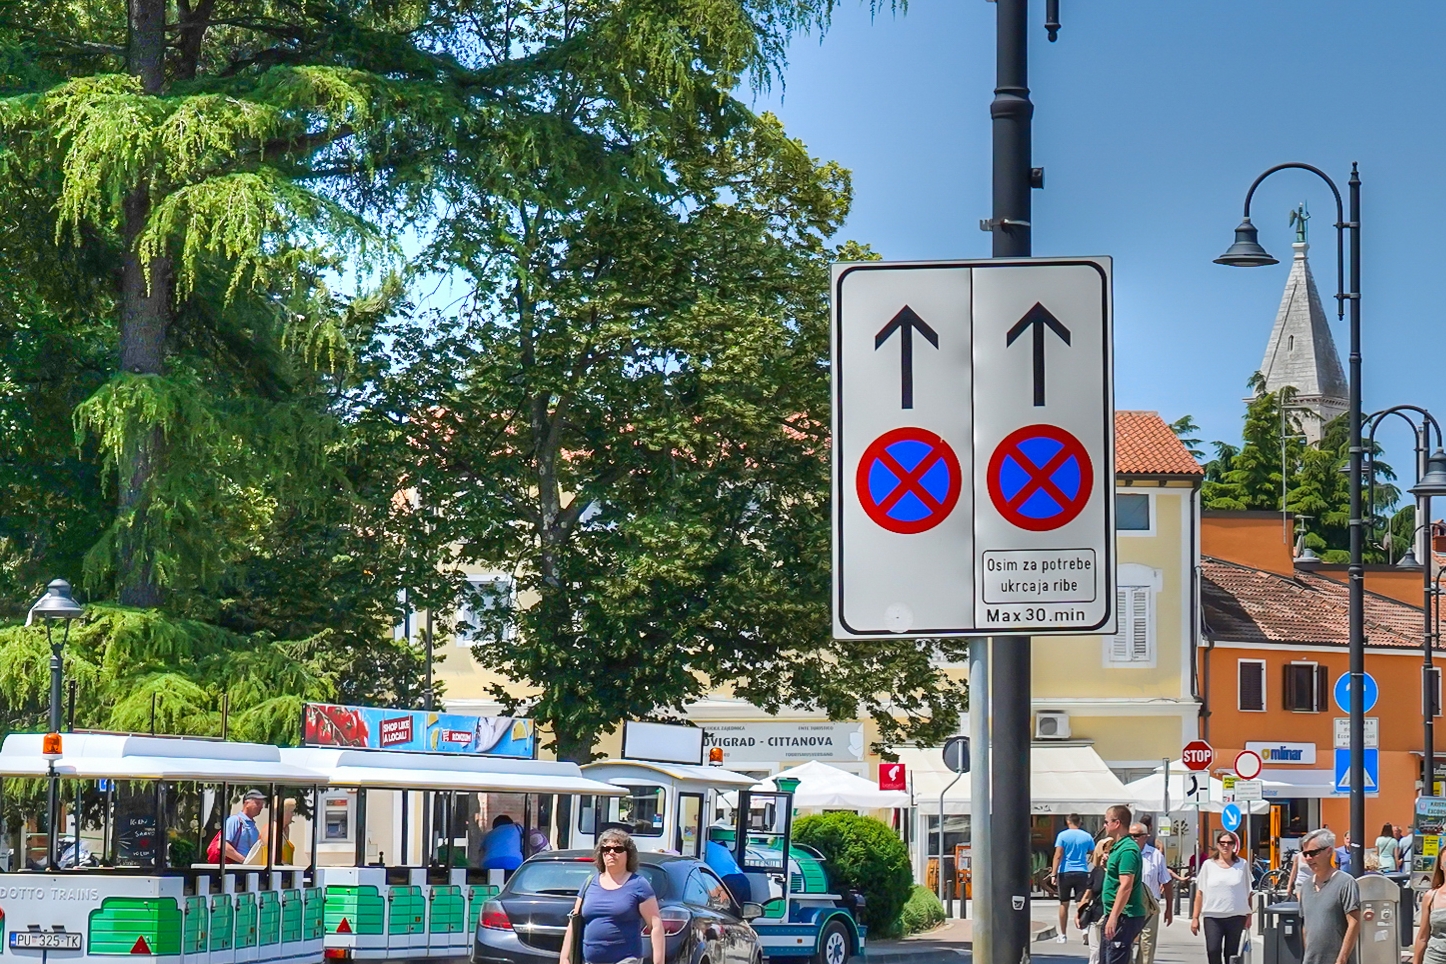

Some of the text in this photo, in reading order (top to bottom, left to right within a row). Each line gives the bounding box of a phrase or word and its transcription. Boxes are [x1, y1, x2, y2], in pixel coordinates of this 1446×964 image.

[987, 557, 1091, 574] Osim za potrebe
[1001, 578, 1078, 595] ukrcaja ribe
[986, 609, 1021, 622] Max
[383, 719, 410, 732] SHOP LIKE
[703, 737, 756, 747] OVIGRAD
[767, 736, 833, 747] CITTANOVA
[1183, 749, 1212, 763] STOP
[1270, 745, 1303, 761] mlinar
[50, 887, 100, 901] TRAINS
[17, 934, 79, 947] PU 325-TK
